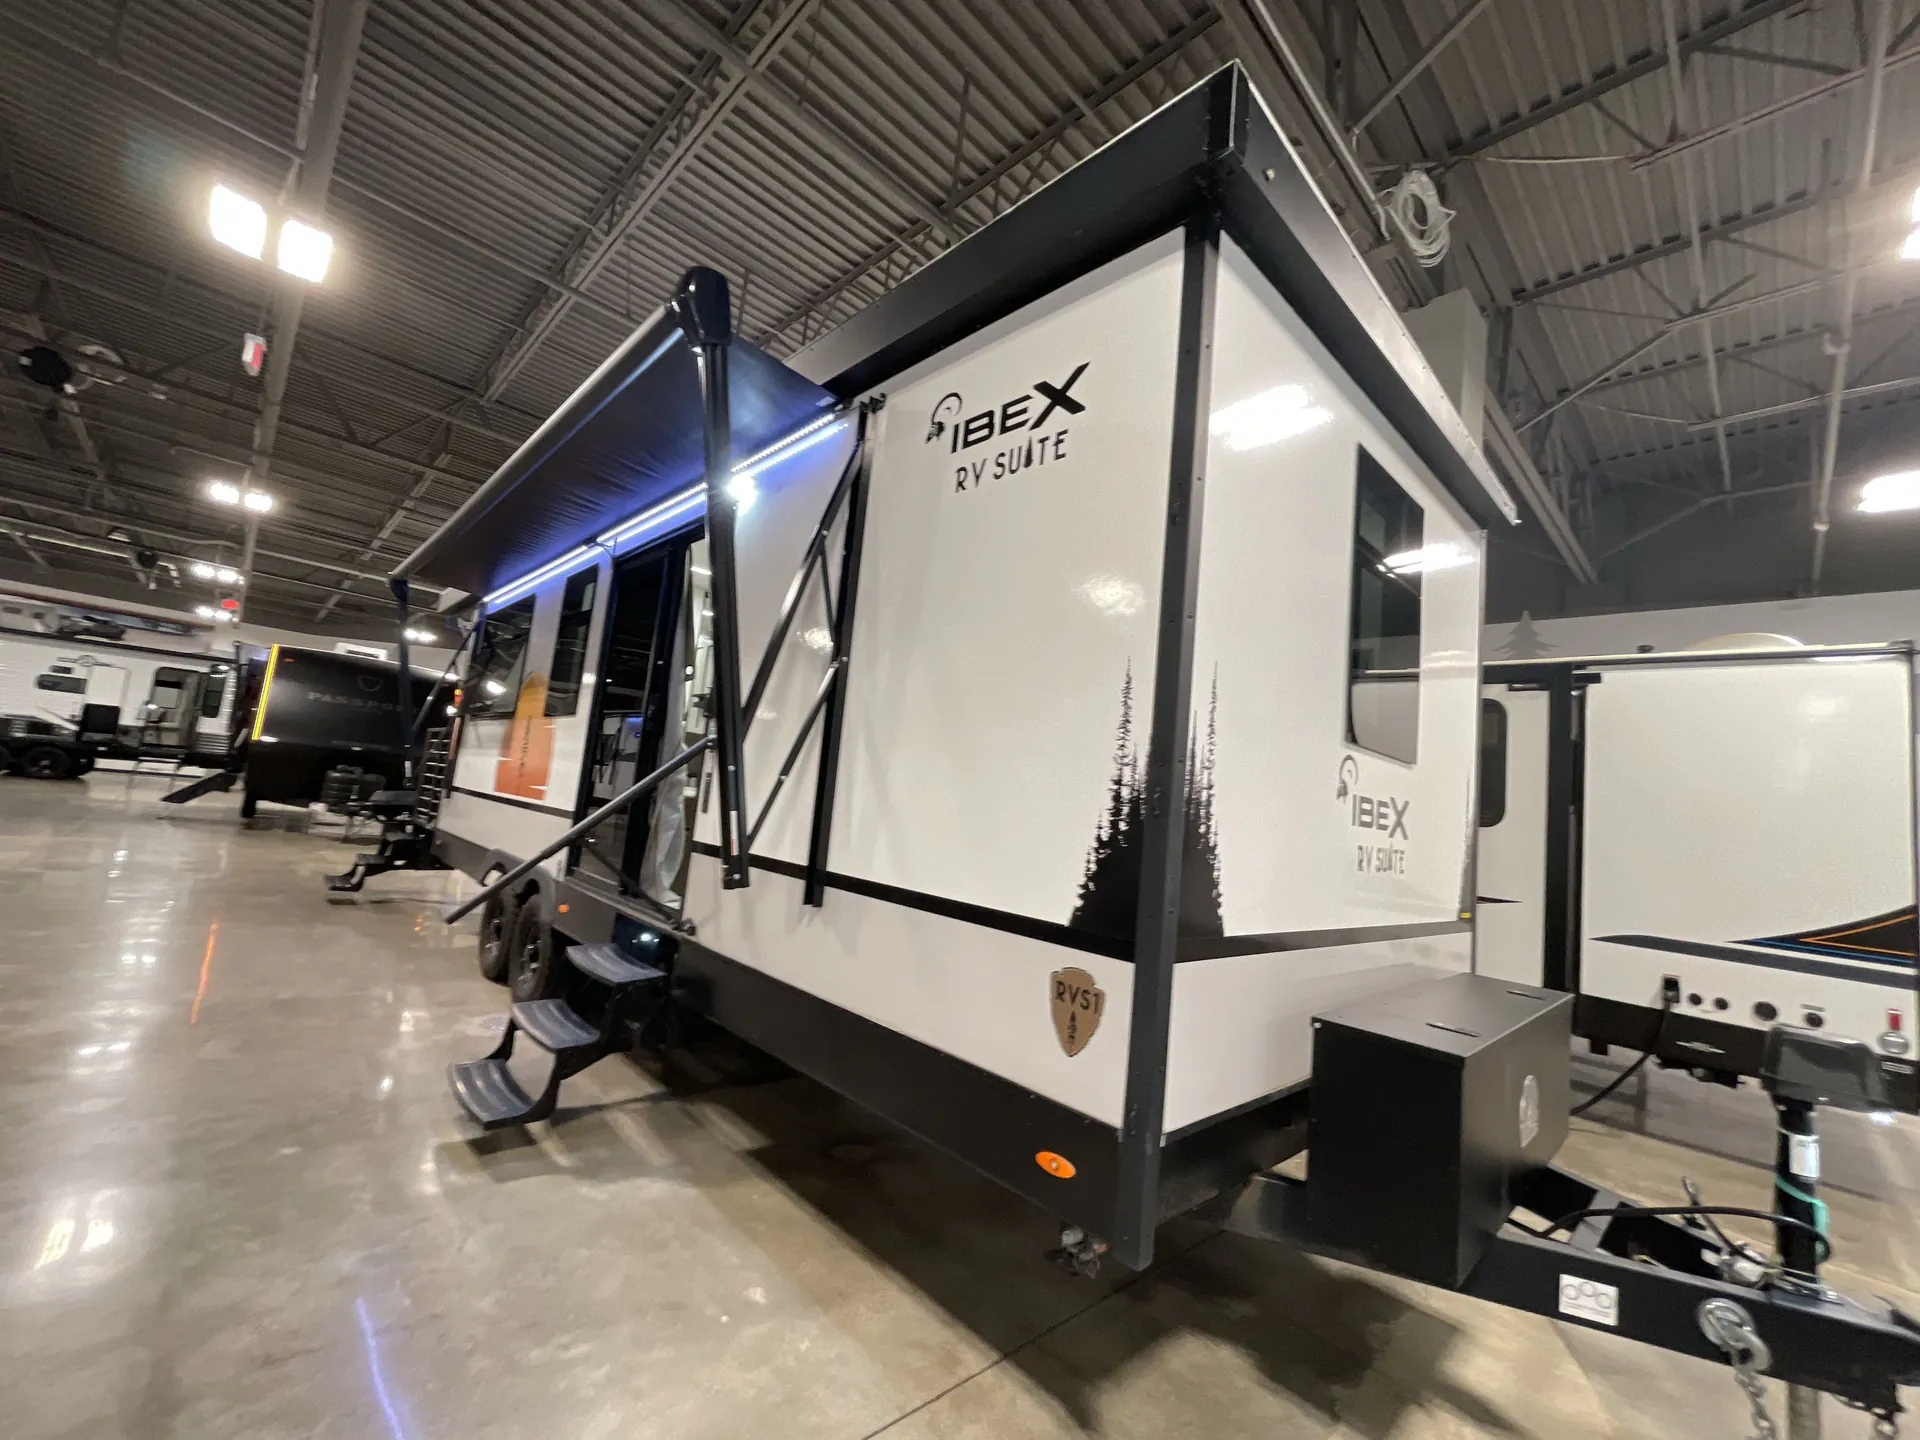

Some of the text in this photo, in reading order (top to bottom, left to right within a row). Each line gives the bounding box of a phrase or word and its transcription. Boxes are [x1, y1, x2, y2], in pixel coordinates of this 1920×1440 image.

[951, 362, 1090, 454] IBEX
[955, 429, 1069, 493] RV SUITE
[1351, 794, 1411, 841] IBEX
[1356, 841, 1406, 875] RV SUITE
[1055, 980, 1100, 1014] RVST
